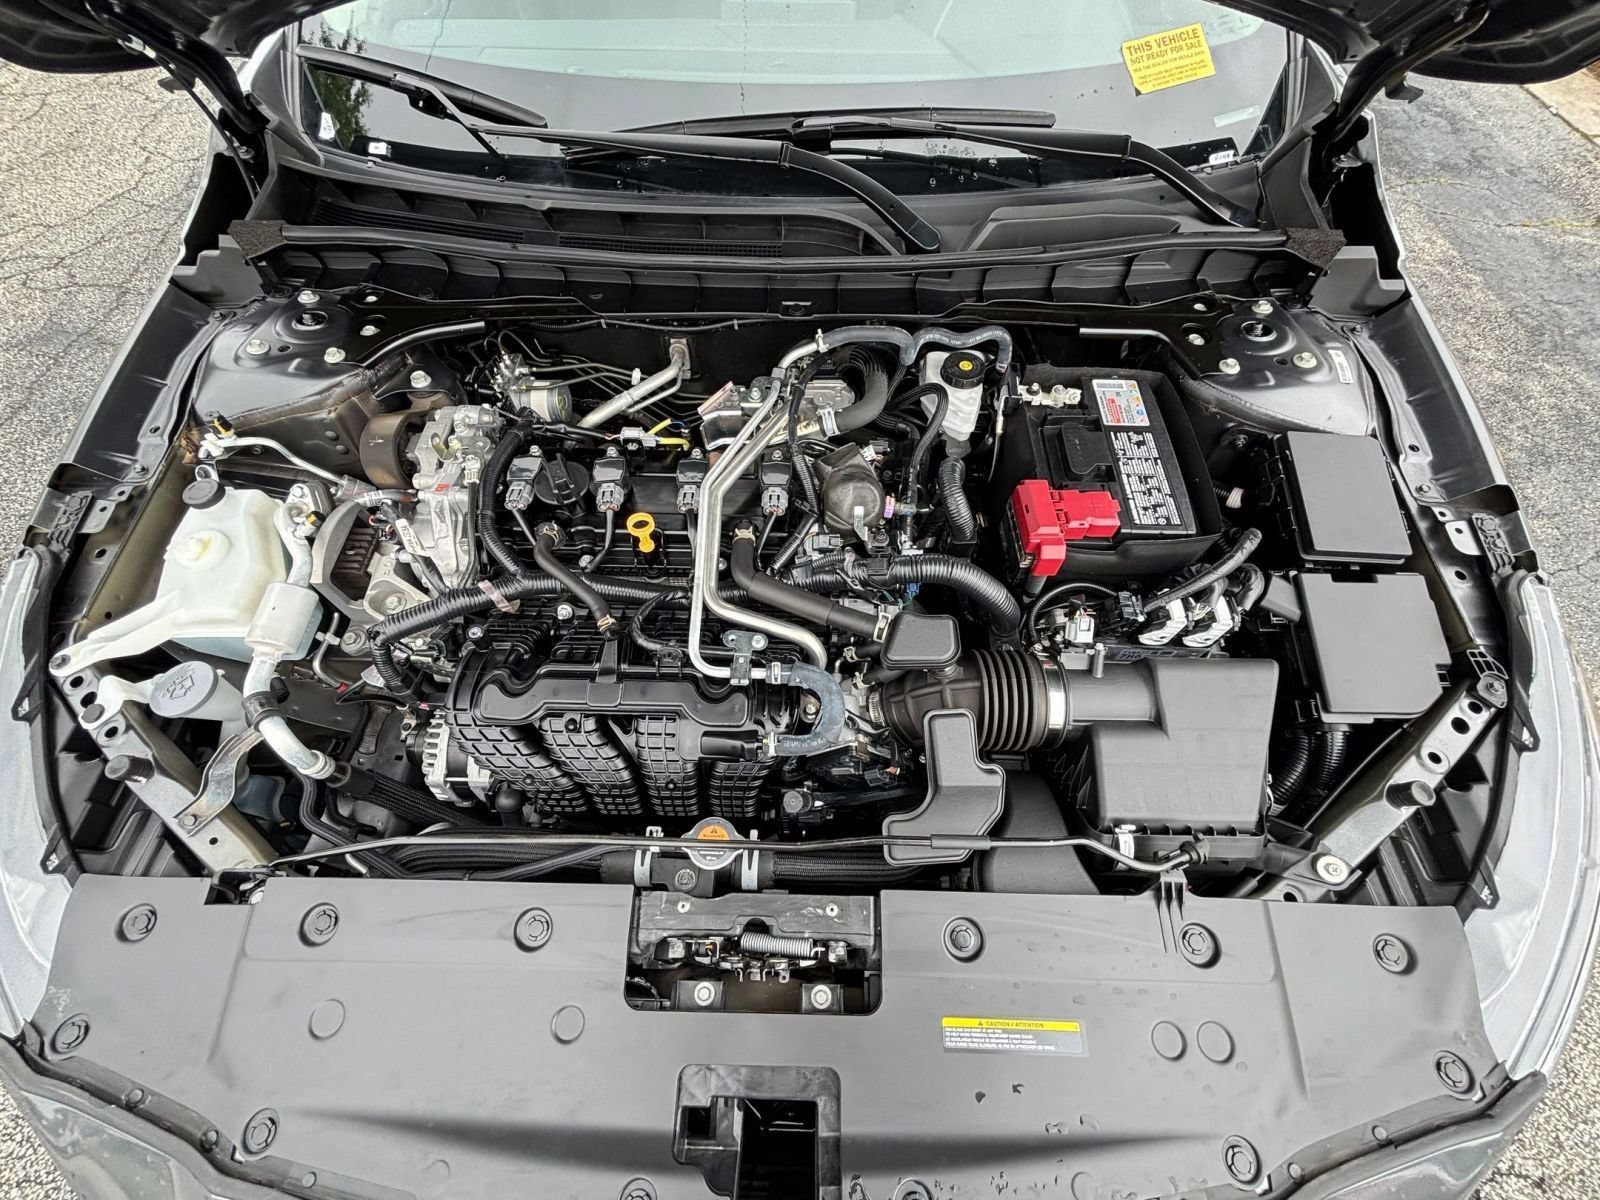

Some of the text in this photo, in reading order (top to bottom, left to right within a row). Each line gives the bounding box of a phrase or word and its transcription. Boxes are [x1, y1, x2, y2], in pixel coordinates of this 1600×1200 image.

[1126, 28, 1200, 56] THIS VEHICLE
[1130, 40, 1202, 65] NOT READY FOR SALE
